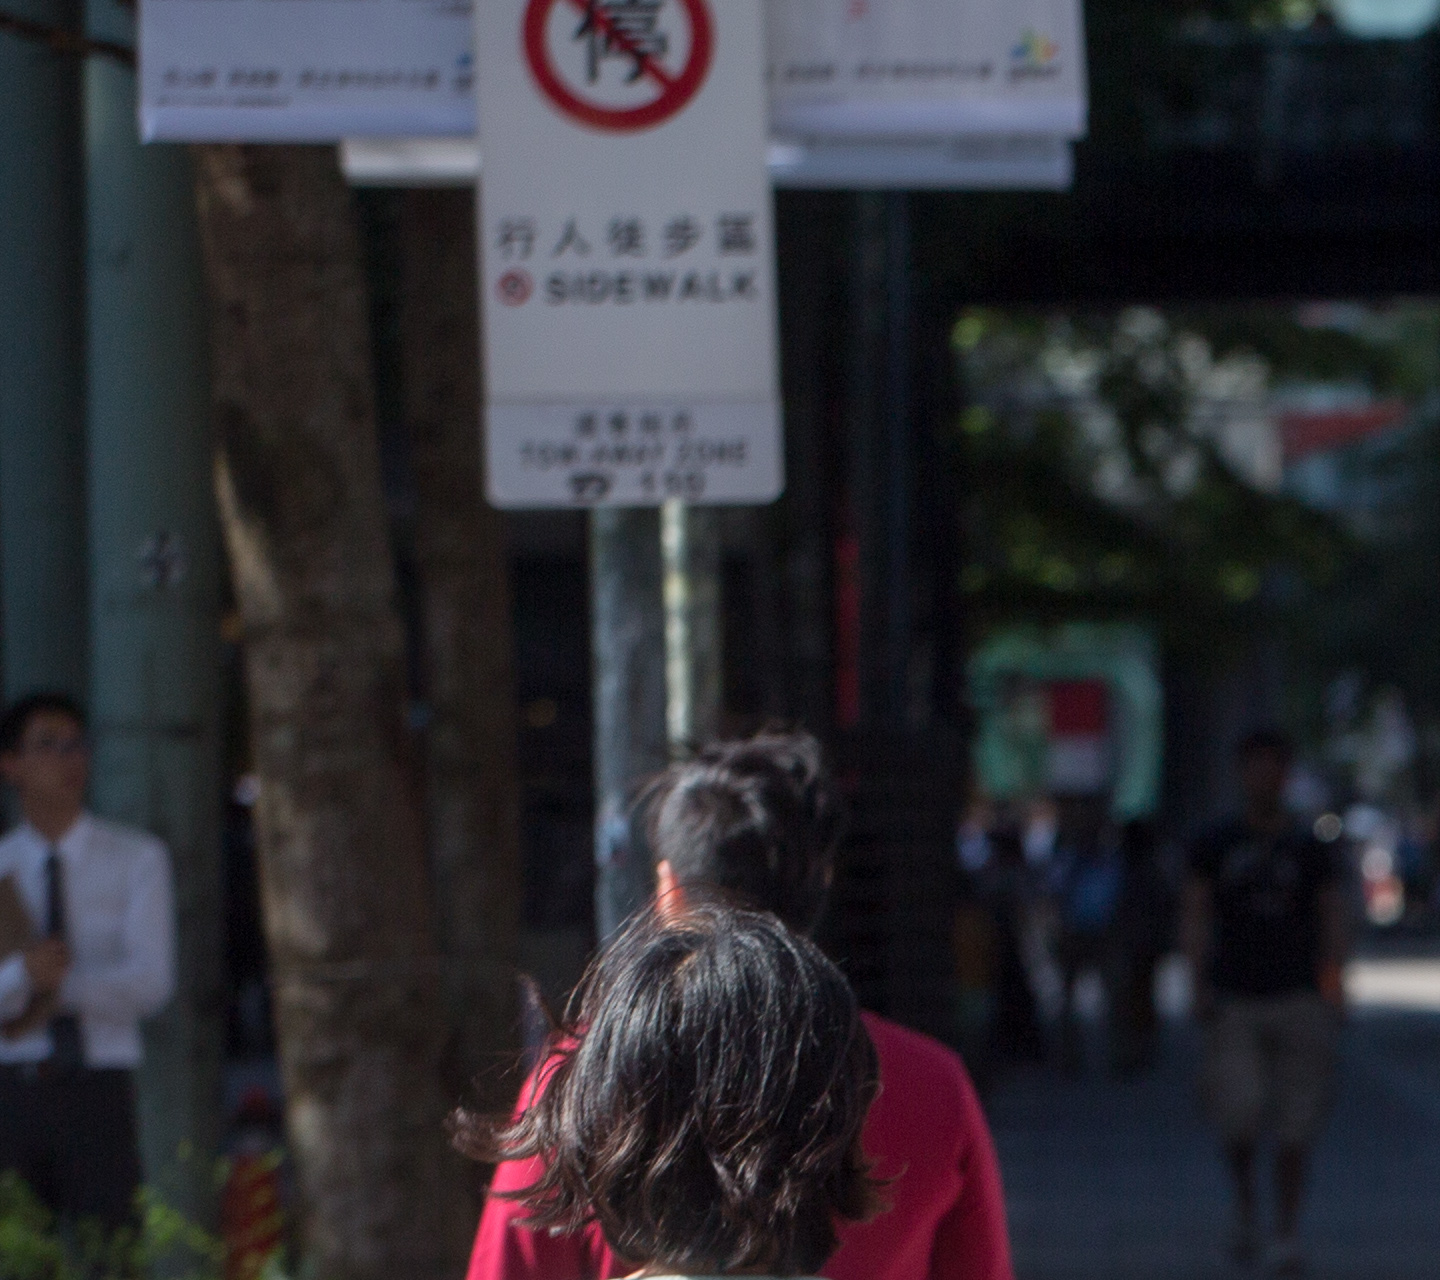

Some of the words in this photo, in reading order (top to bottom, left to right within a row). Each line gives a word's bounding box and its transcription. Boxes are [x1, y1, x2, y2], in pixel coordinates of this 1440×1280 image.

[498, 212, 752, 258] 行人徒步區
[546, 270, 754, 304] SIDEWALK
